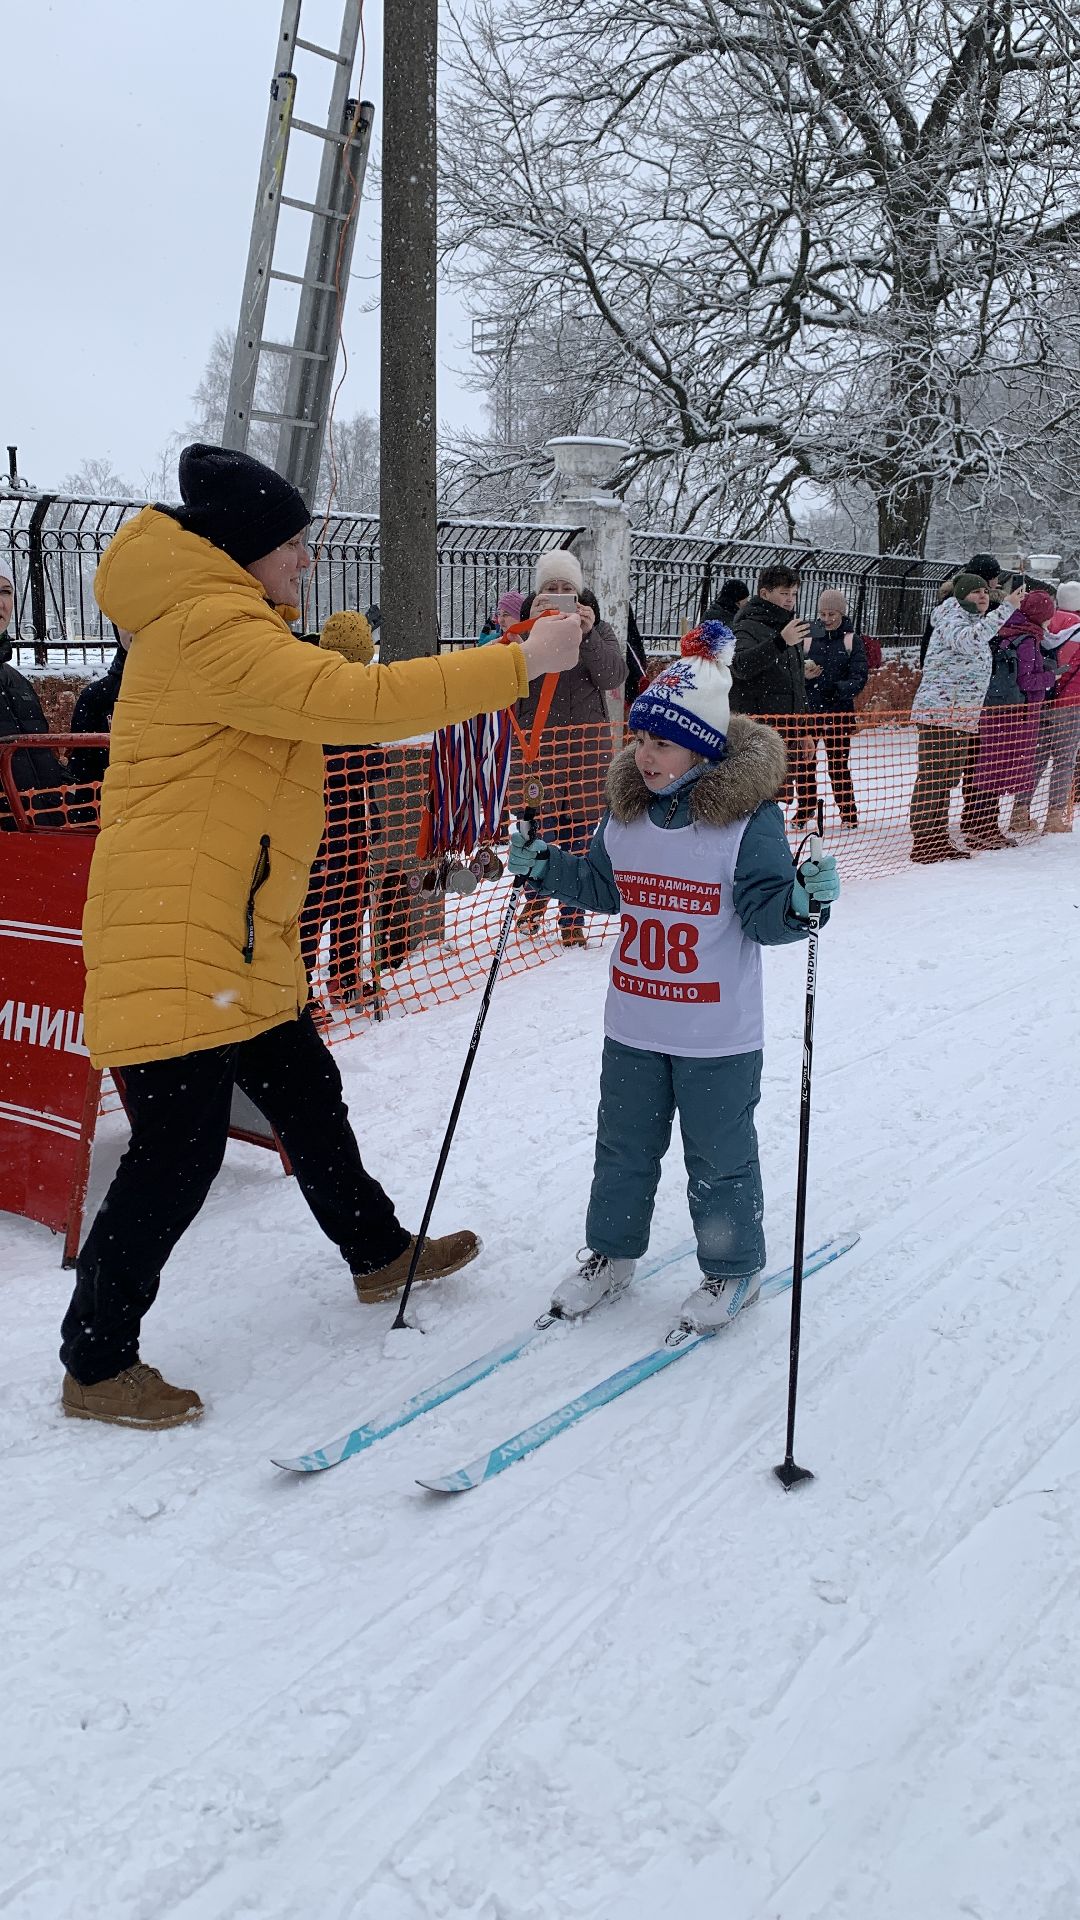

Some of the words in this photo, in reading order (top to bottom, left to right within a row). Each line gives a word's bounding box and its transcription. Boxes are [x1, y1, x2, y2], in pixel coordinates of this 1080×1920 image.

[650, 704, 720, 748] РОССИИ
[614, 874, 656, 887] МЕМРИАЛ
[659, 879, 720, 896] АДМИРАЛА
[639, 890, 712, 912] БЕЛЯЕВА
[620, 913, 699, 974] 208
[806, 938, 816, 992] NORDWAY
[619, 975, 698, 1000] СТУПИНО
